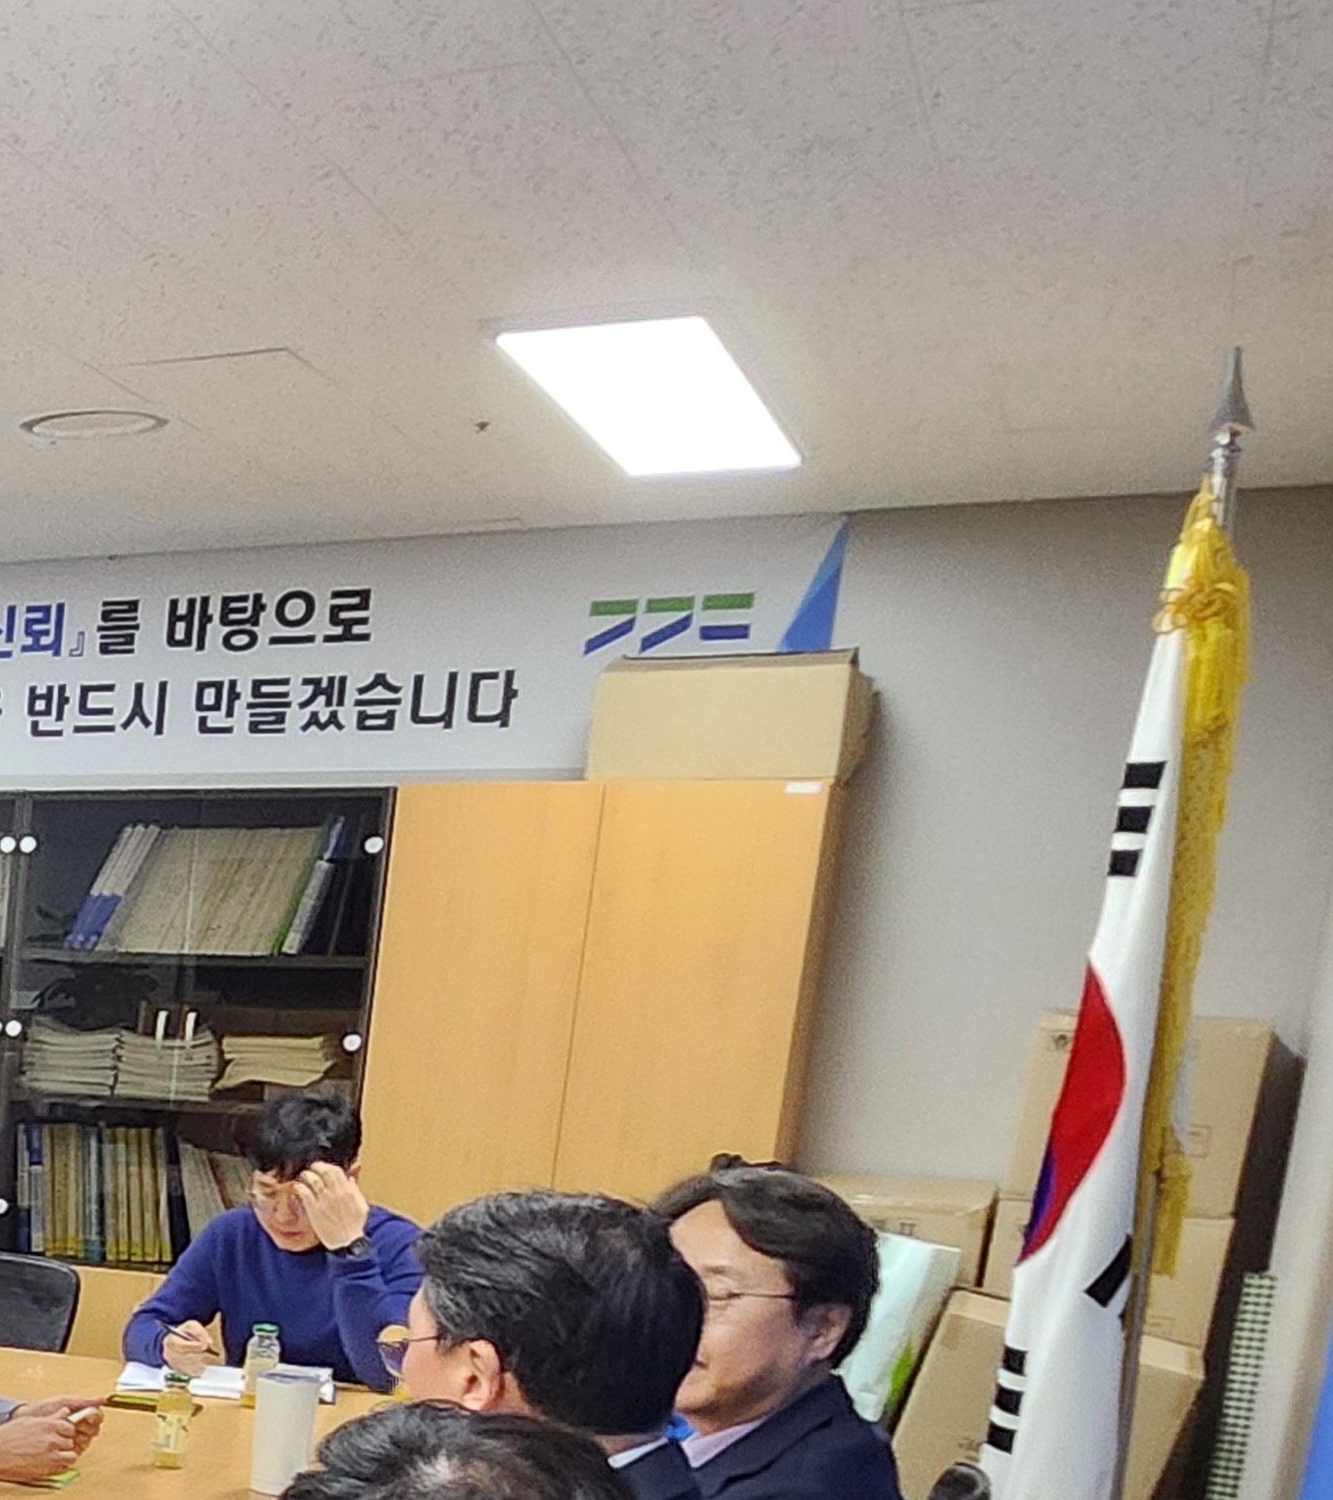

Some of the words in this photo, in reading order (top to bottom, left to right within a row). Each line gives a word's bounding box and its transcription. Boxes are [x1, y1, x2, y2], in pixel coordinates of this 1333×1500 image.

[165, 588, 372, 654] 바탕으로
[26, 678, 169, 738] 반드시
[194, 667, 520, 734] 만들겠습니다
